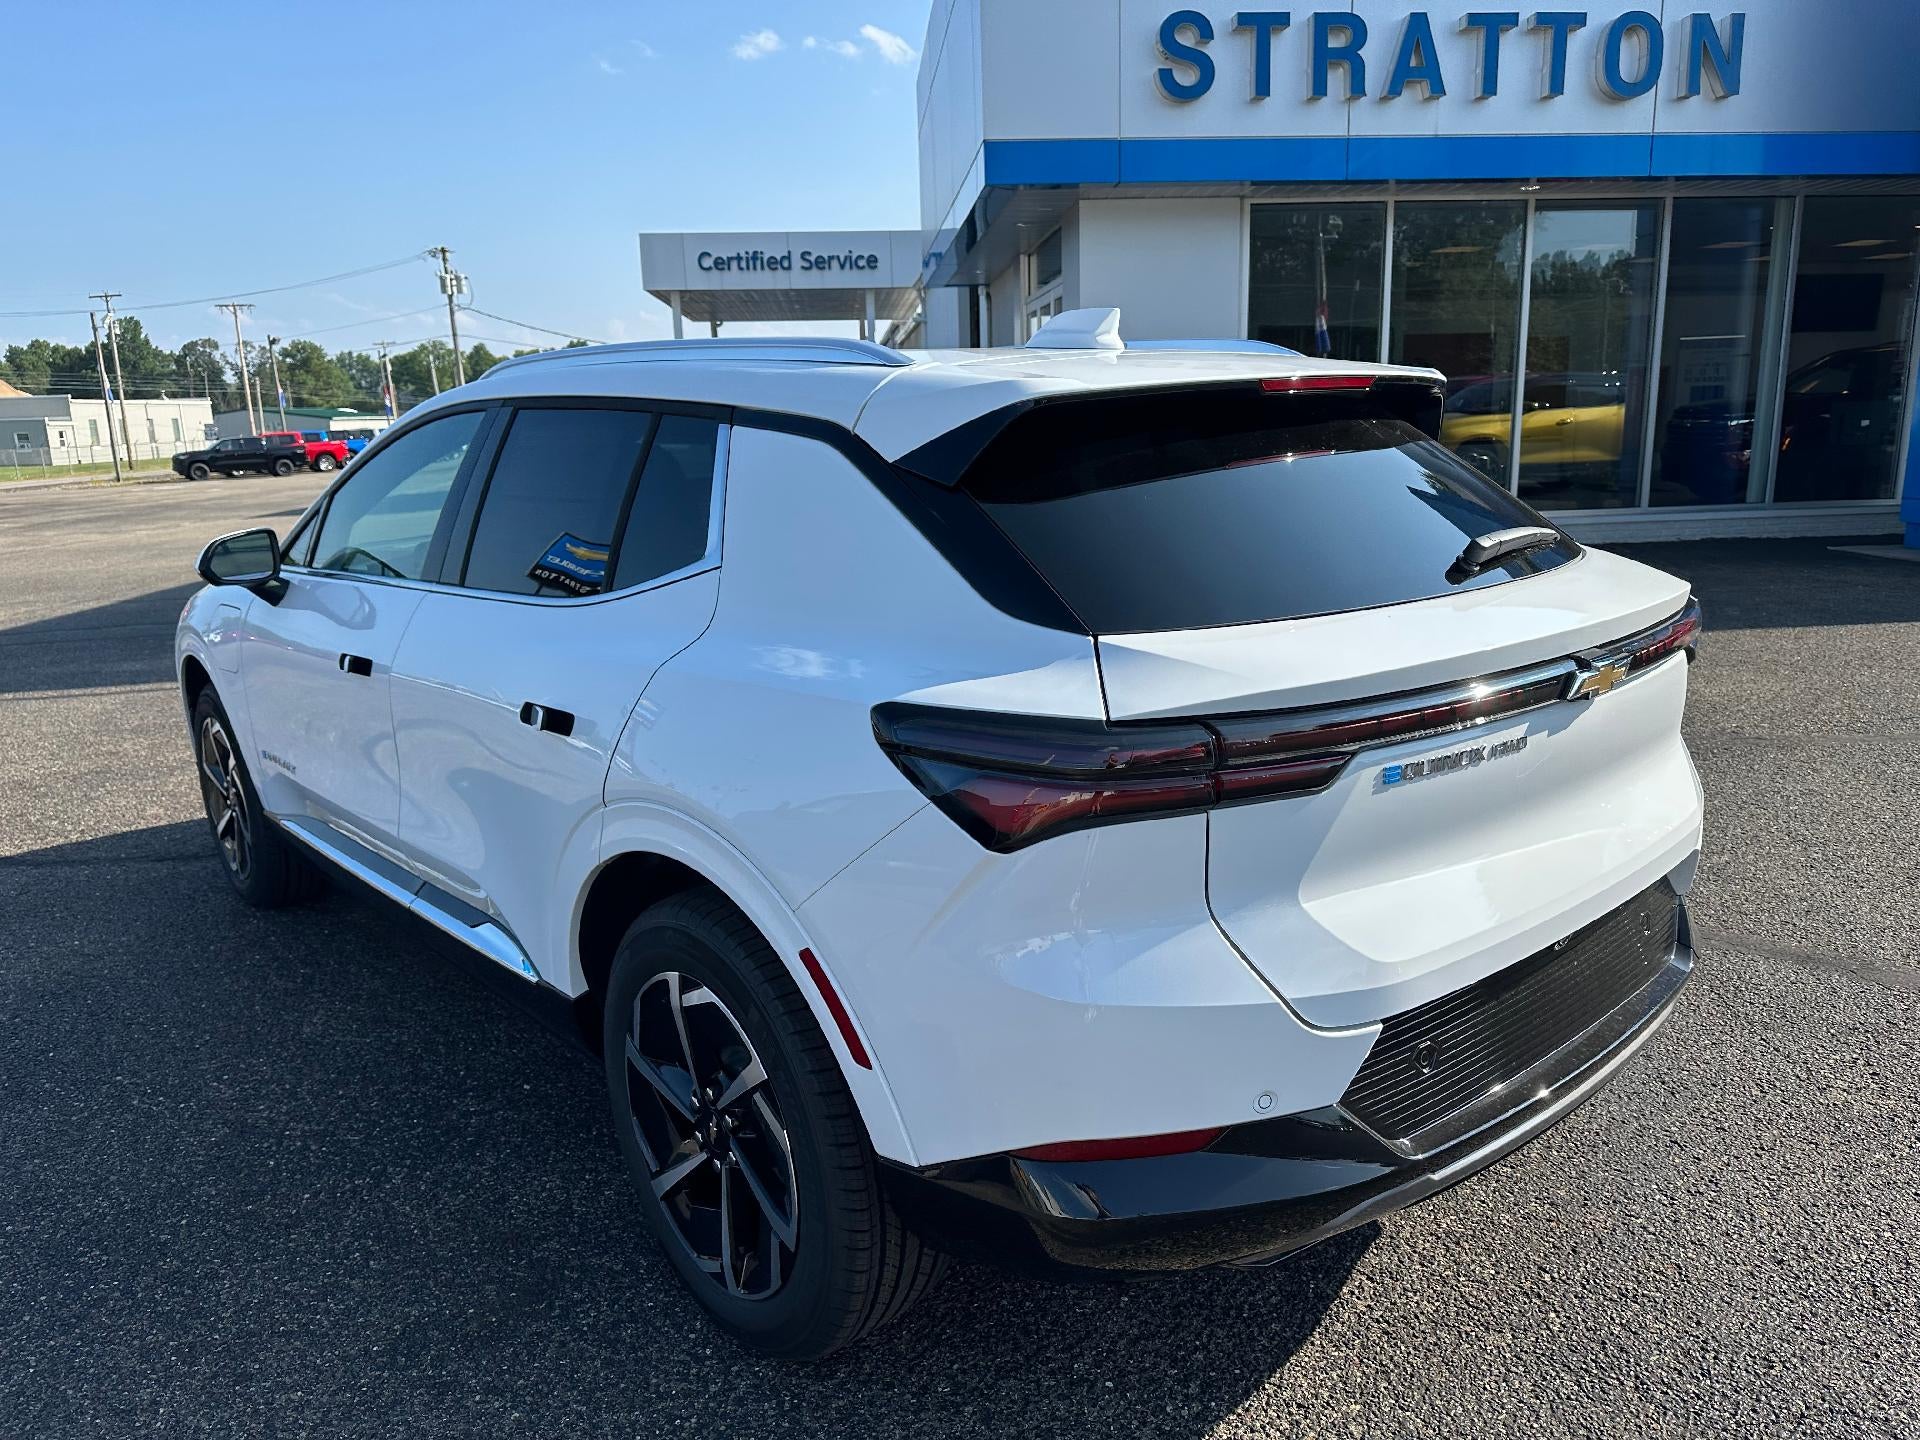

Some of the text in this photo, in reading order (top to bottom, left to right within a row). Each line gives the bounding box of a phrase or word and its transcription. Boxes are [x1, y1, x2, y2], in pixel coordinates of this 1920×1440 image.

[1156, 10, 1745, 101] STRATTON
[697, 249, 879, 271] Certified Service
